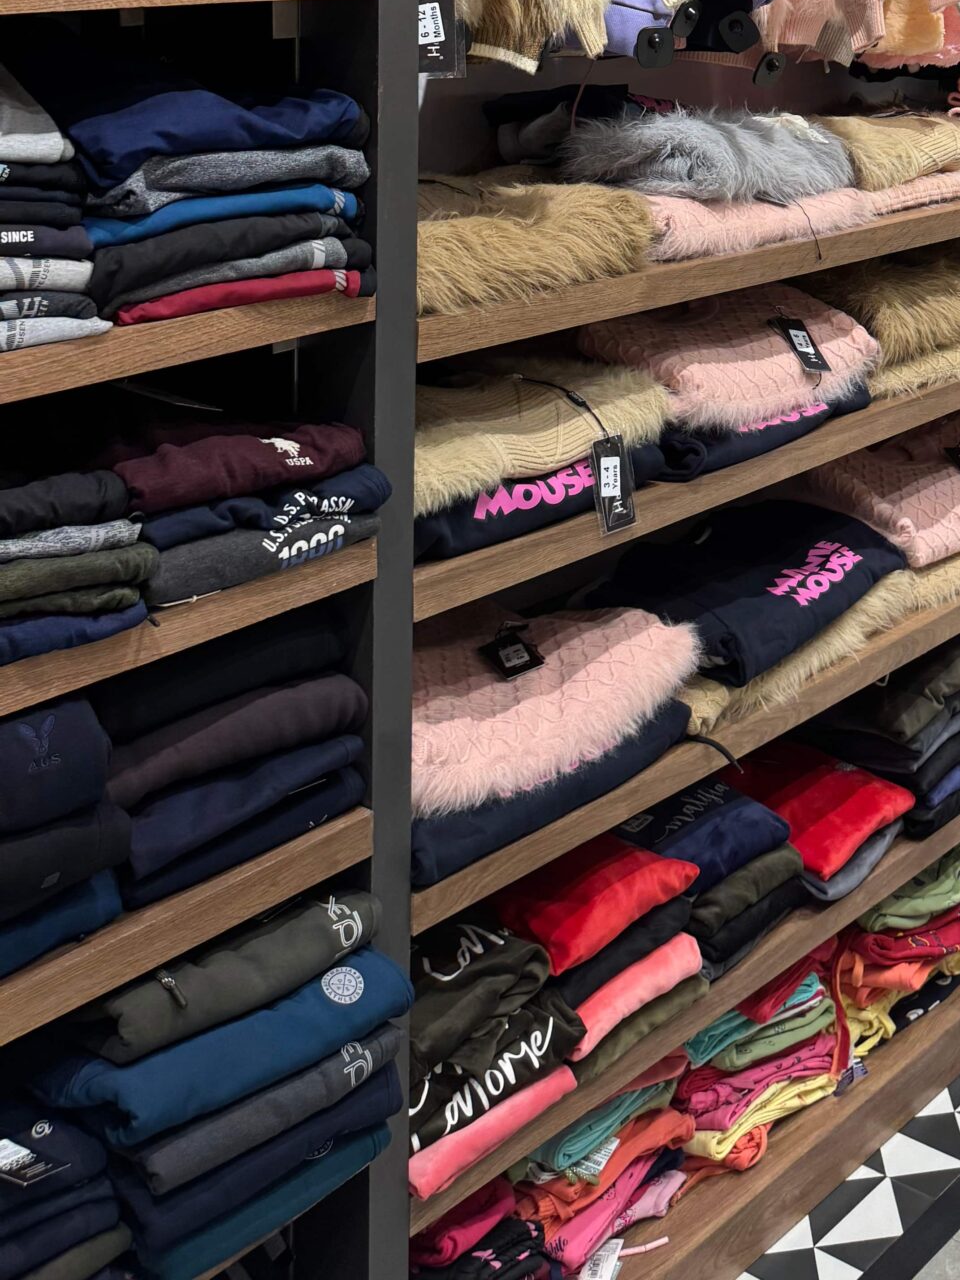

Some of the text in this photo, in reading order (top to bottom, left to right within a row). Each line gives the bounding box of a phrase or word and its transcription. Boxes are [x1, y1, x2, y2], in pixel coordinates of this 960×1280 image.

[430, 6, 442, 38] Months
[0, 230, 35, 243] SINCE
[285, 456, 314, 466] USPA
[603, 466, 610, 475] 4
[473, 458, 597, 520] MOUSE
[604, 481, 611, 489] 3
[790, 546, 864, 608] MOUSE
